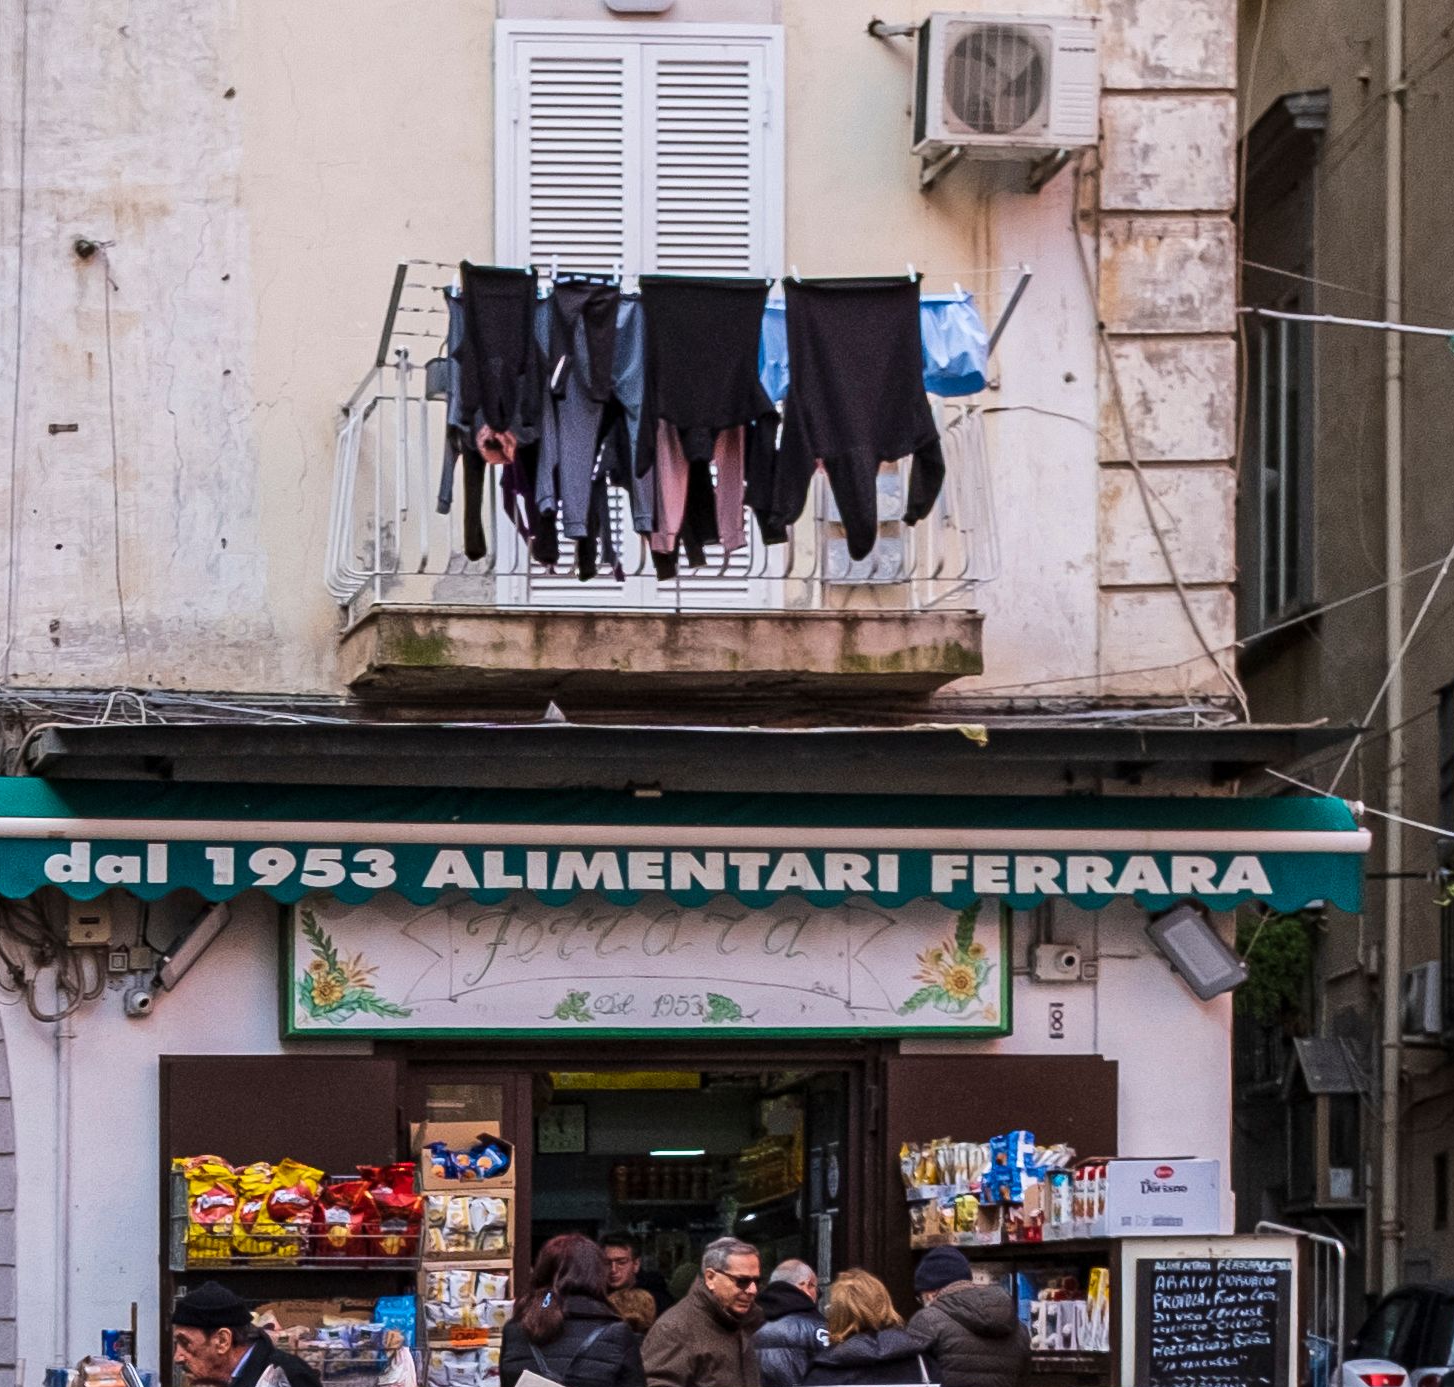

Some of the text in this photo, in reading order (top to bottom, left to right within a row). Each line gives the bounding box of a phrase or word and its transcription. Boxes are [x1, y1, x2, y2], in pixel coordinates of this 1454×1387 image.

[44, 842, 1272, 895] dal 1953 ALIMENTARI FERRARA
